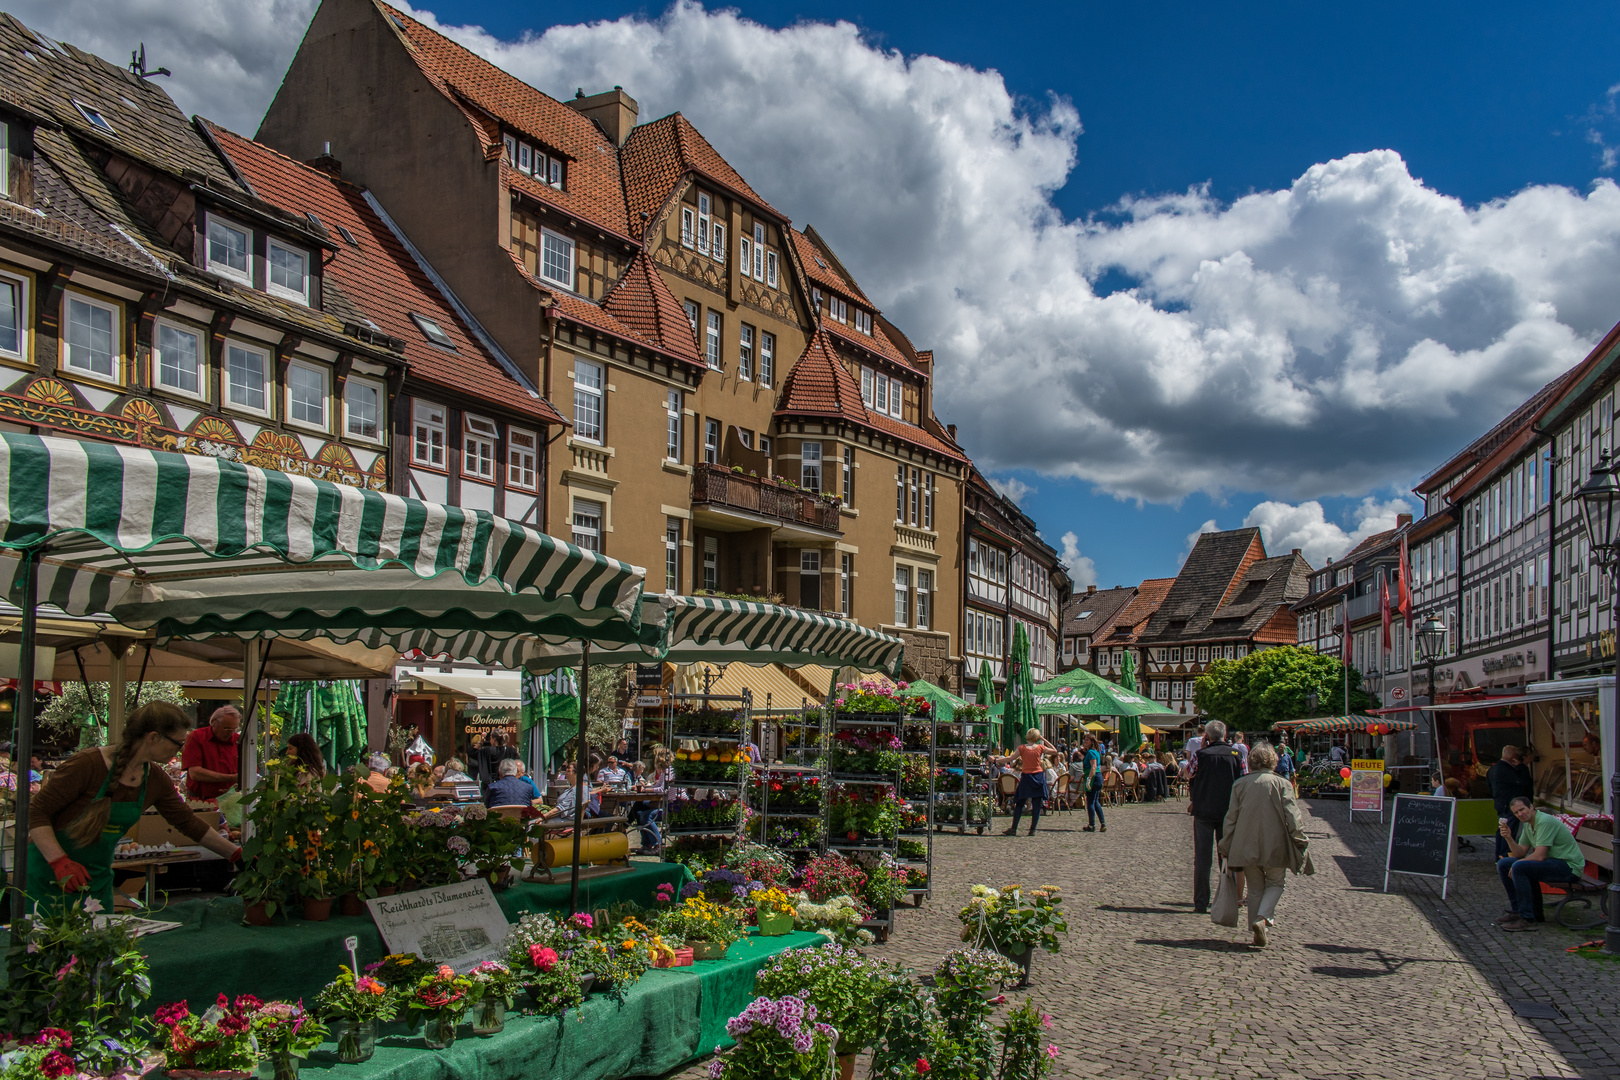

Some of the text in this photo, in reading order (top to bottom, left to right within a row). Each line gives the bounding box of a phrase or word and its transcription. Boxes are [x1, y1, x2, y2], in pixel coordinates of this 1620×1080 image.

[472, 714, 510, 725] Dolomiti
[465, 725, 490, 734] GELATO
[432, 885, 484, 905] Blumenecke
